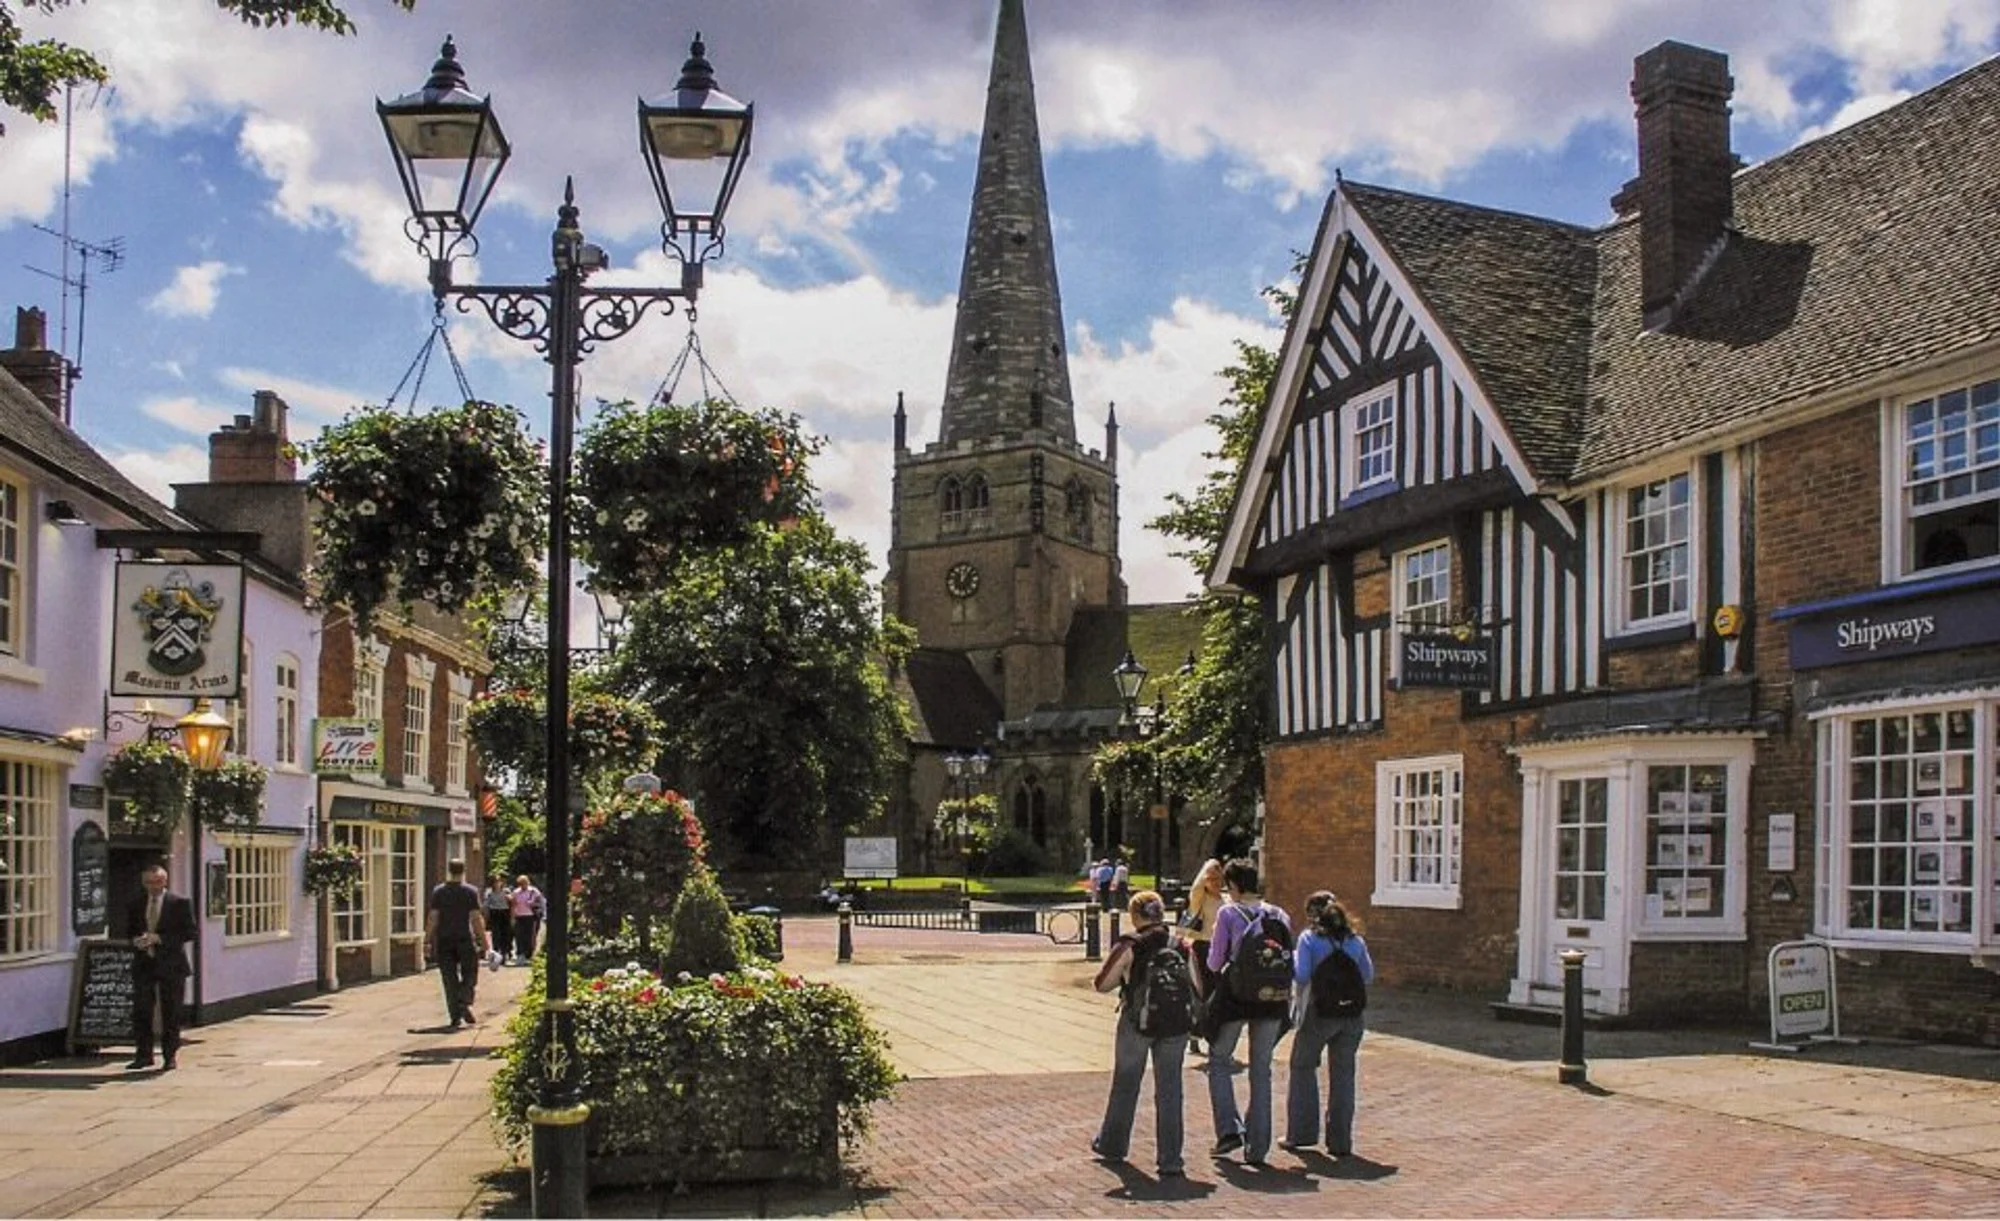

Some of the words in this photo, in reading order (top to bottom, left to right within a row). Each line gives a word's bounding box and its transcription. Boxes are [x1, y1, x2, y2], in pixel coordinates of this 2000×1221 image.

[1837, 616, 1935, 652] Shipways
[1407, 641, 1488, 669] Shipways
[1783, 993, 1823, 1012] OPEN
